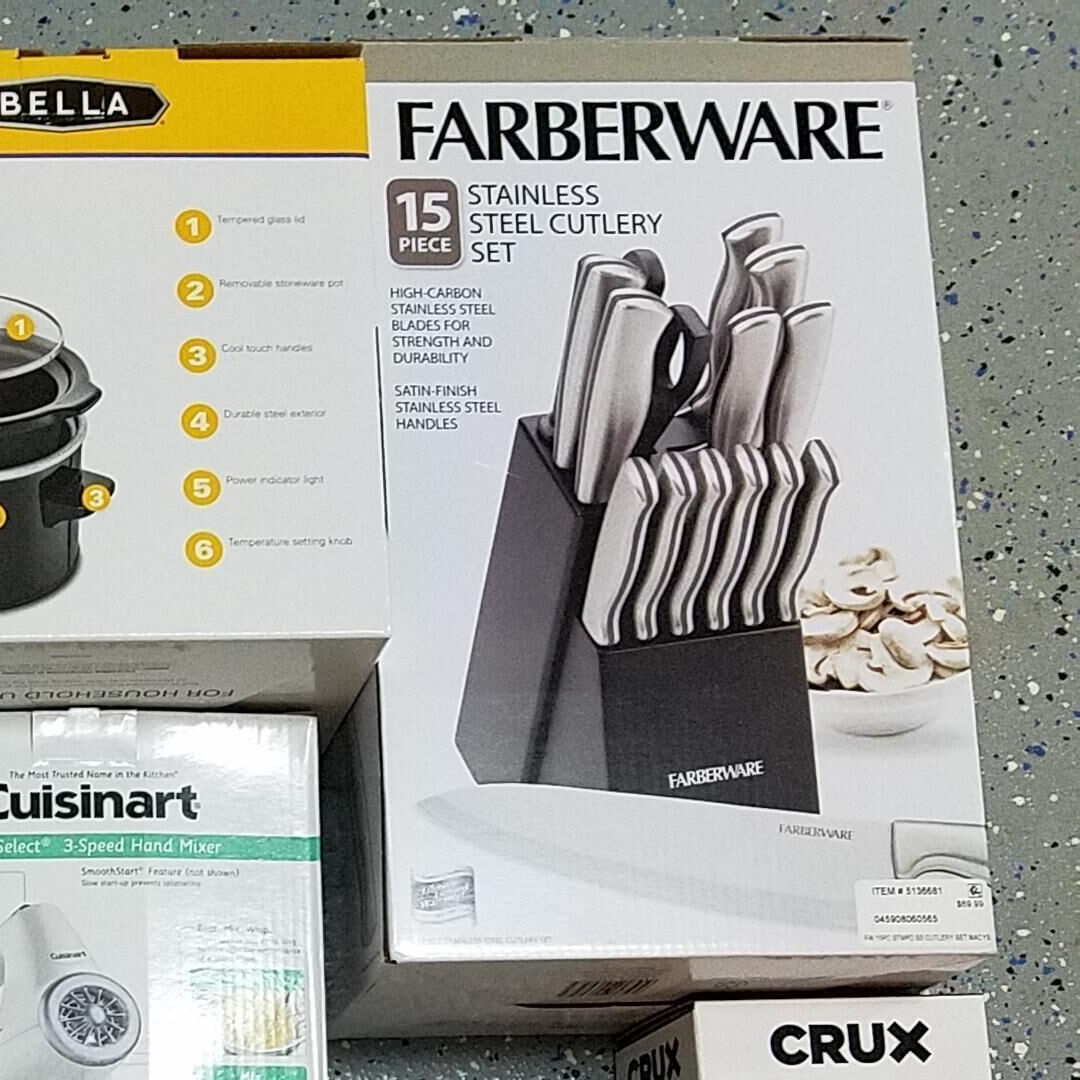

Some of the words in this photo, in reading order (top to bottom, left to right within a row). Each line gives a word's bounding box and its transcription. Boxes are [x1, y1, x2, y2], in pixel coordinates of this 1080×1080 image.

[0, 92, 129, 116] BELLA
[396, 100, 884, 162] FARBERWARE
[467, 185, 599, 206] STAINLESS
[395, 191, 452, 232] 15
[218, 215, 264, 225] Tempered
[268, 216, 291, 226] glass
[294, 215, 305, 224] lid
[469, 214, 543, 234] STEEL
[549, 214, 662, 234] CUTLERY
[399, 237, 452, 253] PIECE
[471, 242, 516, 263] SET
[219, 279, 272, 288] Removable
[328, 280, 344, 288] pot
[390, 288, 482, 298] HIGH-CARBON
[391, 304, 456, 315] STAINLESS
[460, 304, 495, 315] STEEL
[392, 320, 440, 331] BLADES
[444, 320, 470, 331] FOR
[392, 336, 459, 347] STRENGTH
[464, 336, 492, 347] AND
[222, 344, 243, 353] Cool
[246, 344, 272, 352] touch
[276, 344, 312, 352] handles
[393, 352, 468, 363] DURABILITY
[395, 385, 476, 396] SATIN-FINISH
[396, 402, 461, 413] STAINLESS
[465, 402, 502, 413] STEEL
[224, 410, 261, 418] Durable
[264, 410, 286, 418] steel
[397, 418, 458, 429] HANDLES
[226, 476, 256, 484] Power
[260, 476, 300, 484] indicator
[304, 475, 324, 485] light
[228, 538, 289, 547] Temperature
[292, 538, 325, 547] setting
[329, 537, 352, 545] knob
[24, 689, 178, 699] HOUSEHOLD
[187, 688, 234, 698] FOR
[668, 760, 764, 789] FARBERWARE
[779, 823, 854, 841] FARBERWARE
[64, 839, 124, 854] 3-Speed
[131, 839, 172, 853] Hand
[179, 840, 221, 855] Mixer
[770, 1021, 932, 1065] CRUX
